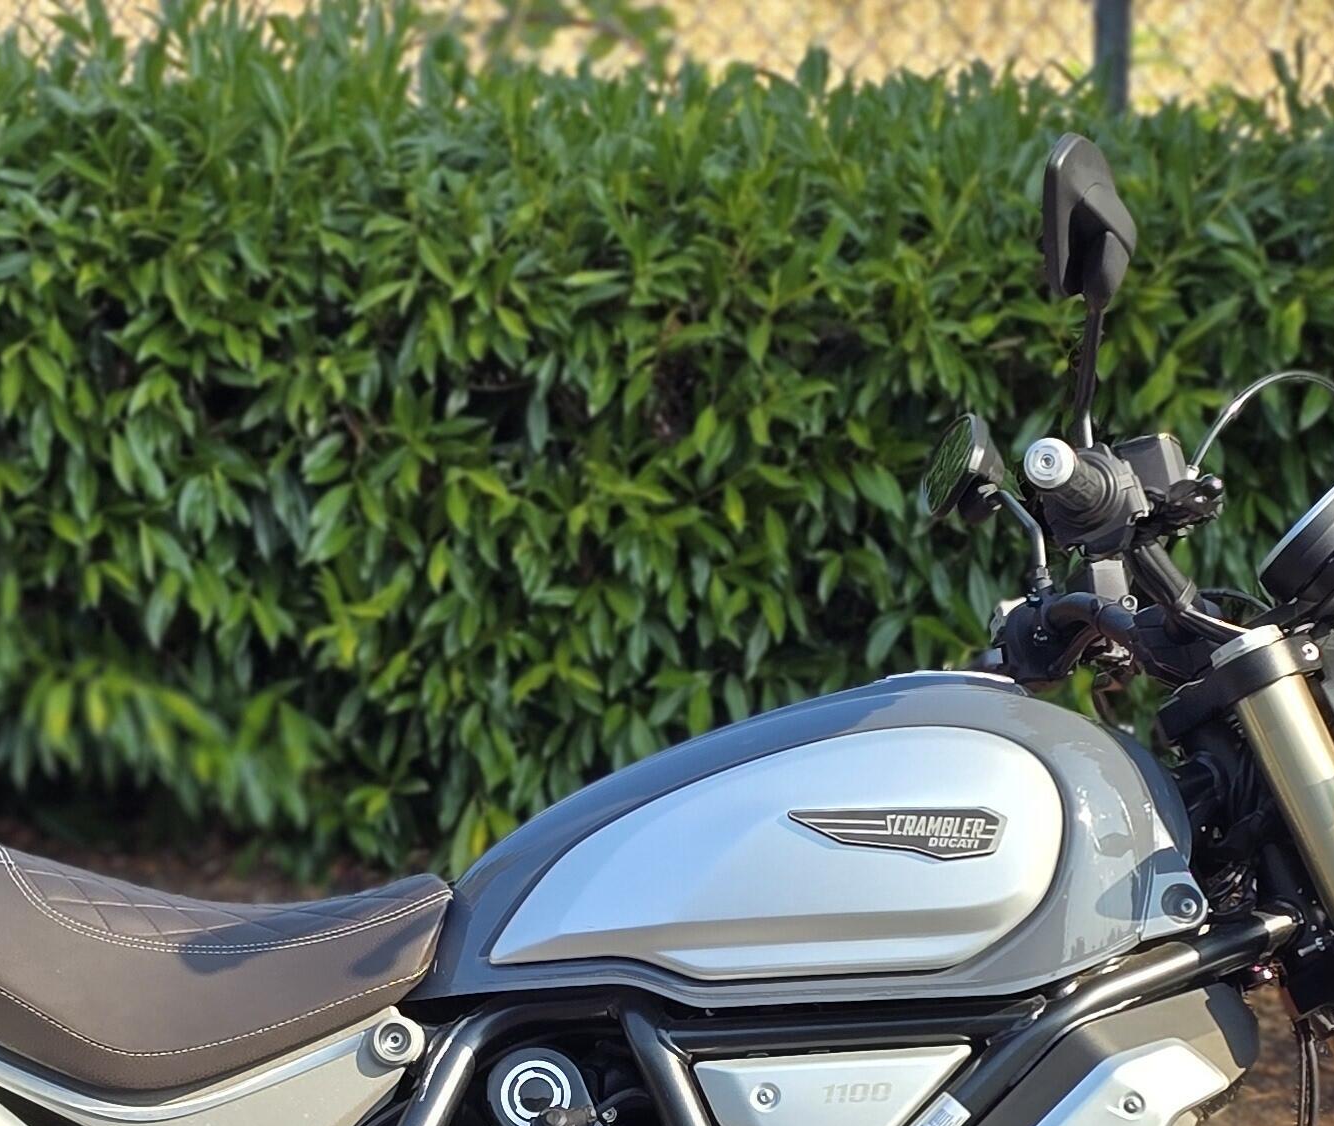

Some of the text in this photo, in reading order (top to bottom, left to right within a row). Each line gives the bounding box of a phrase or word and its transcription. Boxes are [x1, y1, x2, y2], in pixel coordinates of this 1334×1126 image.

[885, 814, 986, 838] SCRAMBLER
[928, 837, 980, 849] DUCATI
[822, 1082, 892, 1104] 1100
